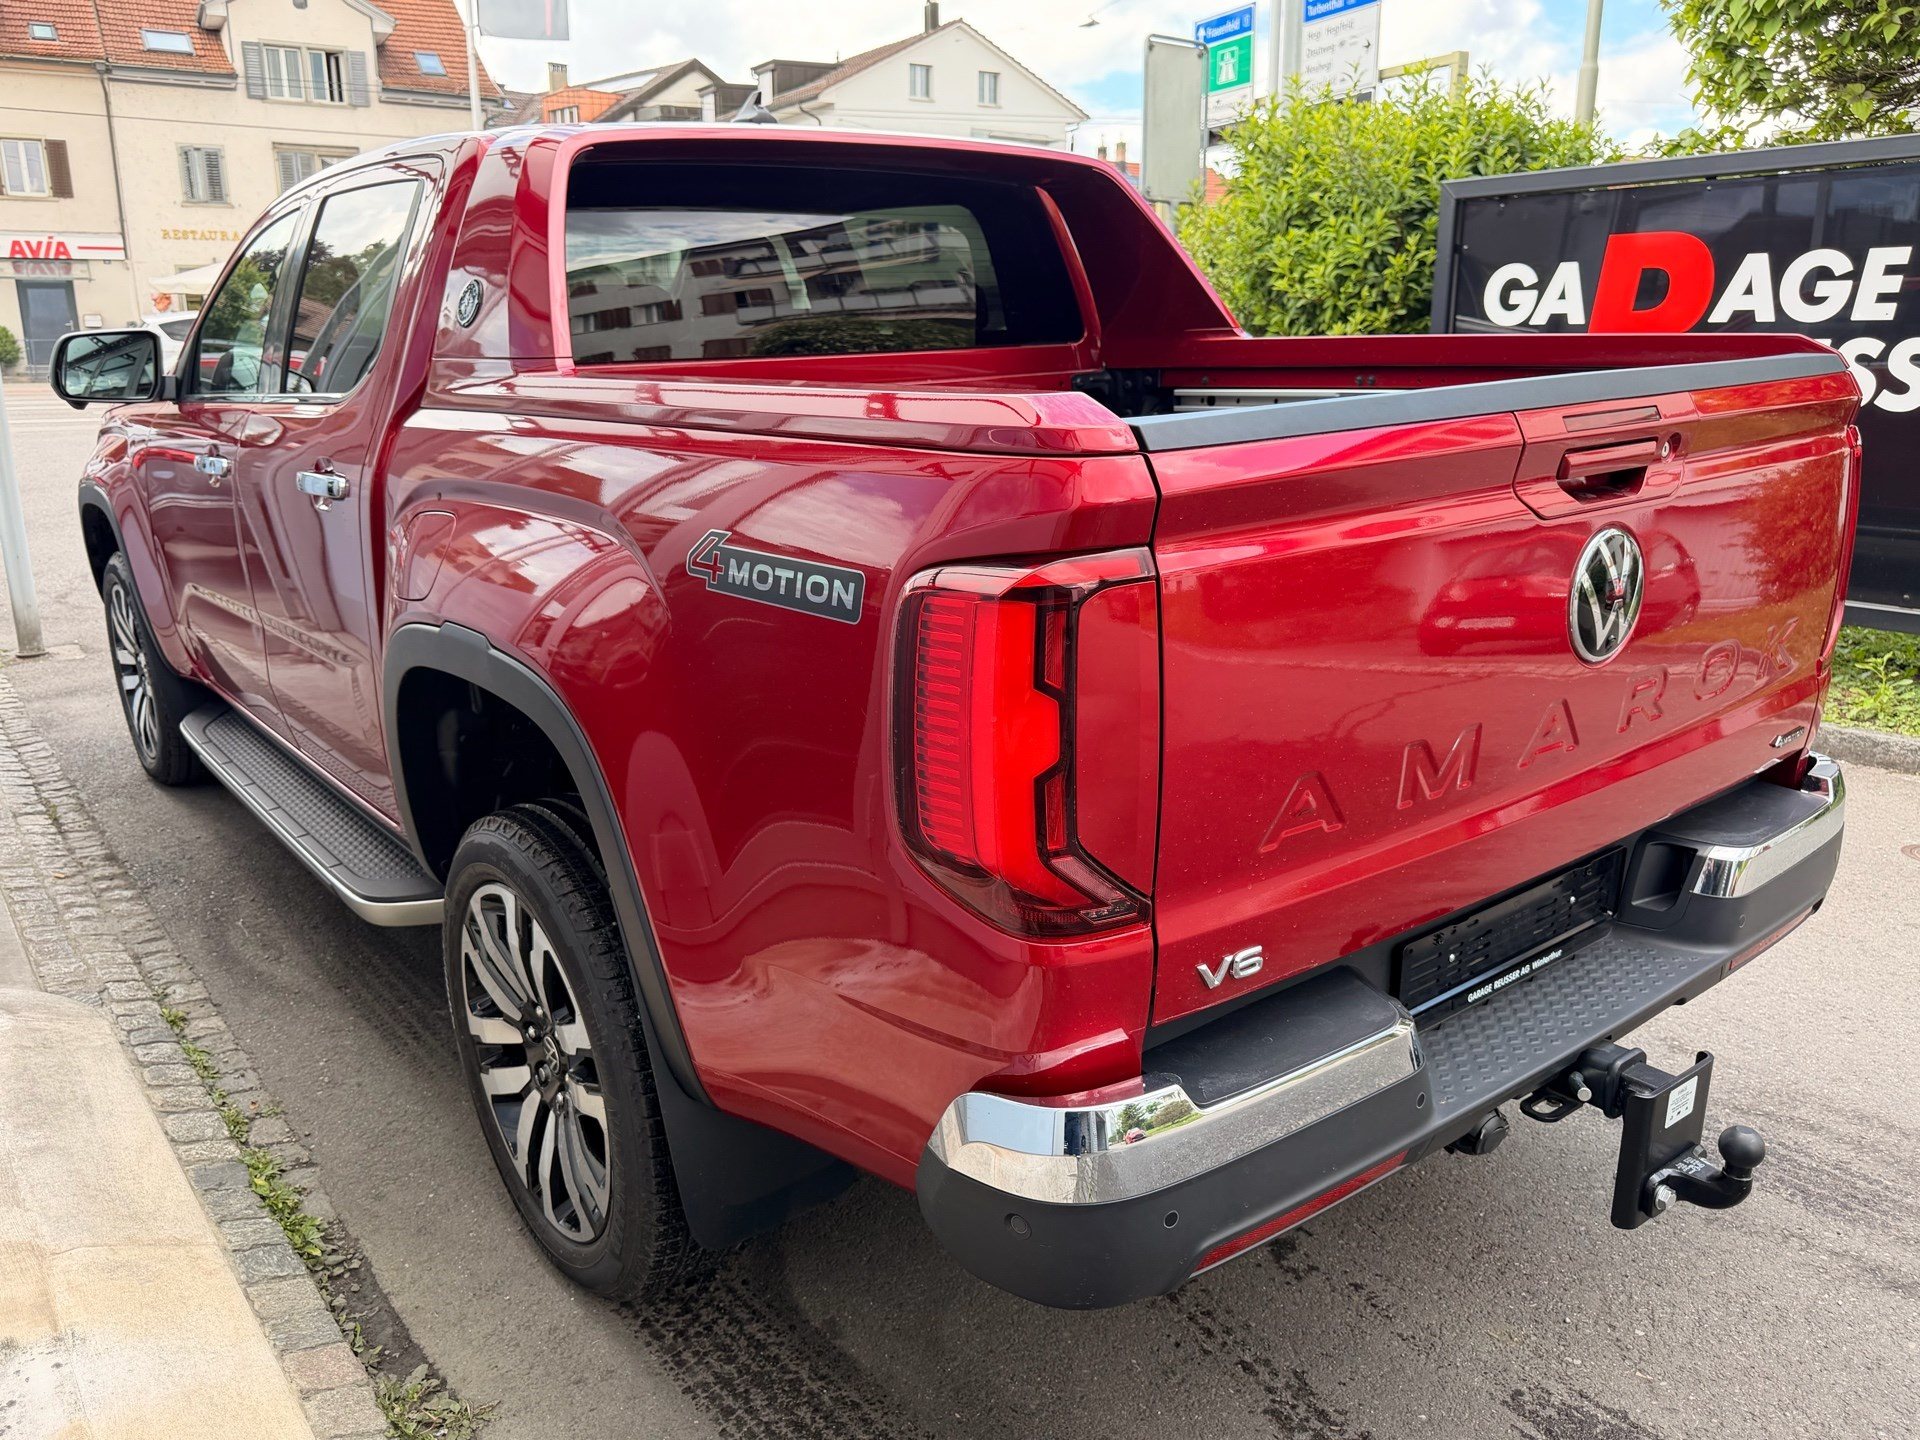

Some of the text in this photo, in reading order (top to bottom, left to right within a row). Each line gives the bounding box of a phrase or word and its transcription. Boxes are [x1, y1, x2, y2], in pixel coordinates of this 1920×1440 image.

[161, 229, 247, 241] RESTAURA
[690, 536, 855, 610] 4MOTION
[1259, 618, 1801, 852] AMAROK
[1196, 945, 1264, 989] V6
[1467, 949, 1562, 1003] GARAGE REUSSER AG Winterthur
